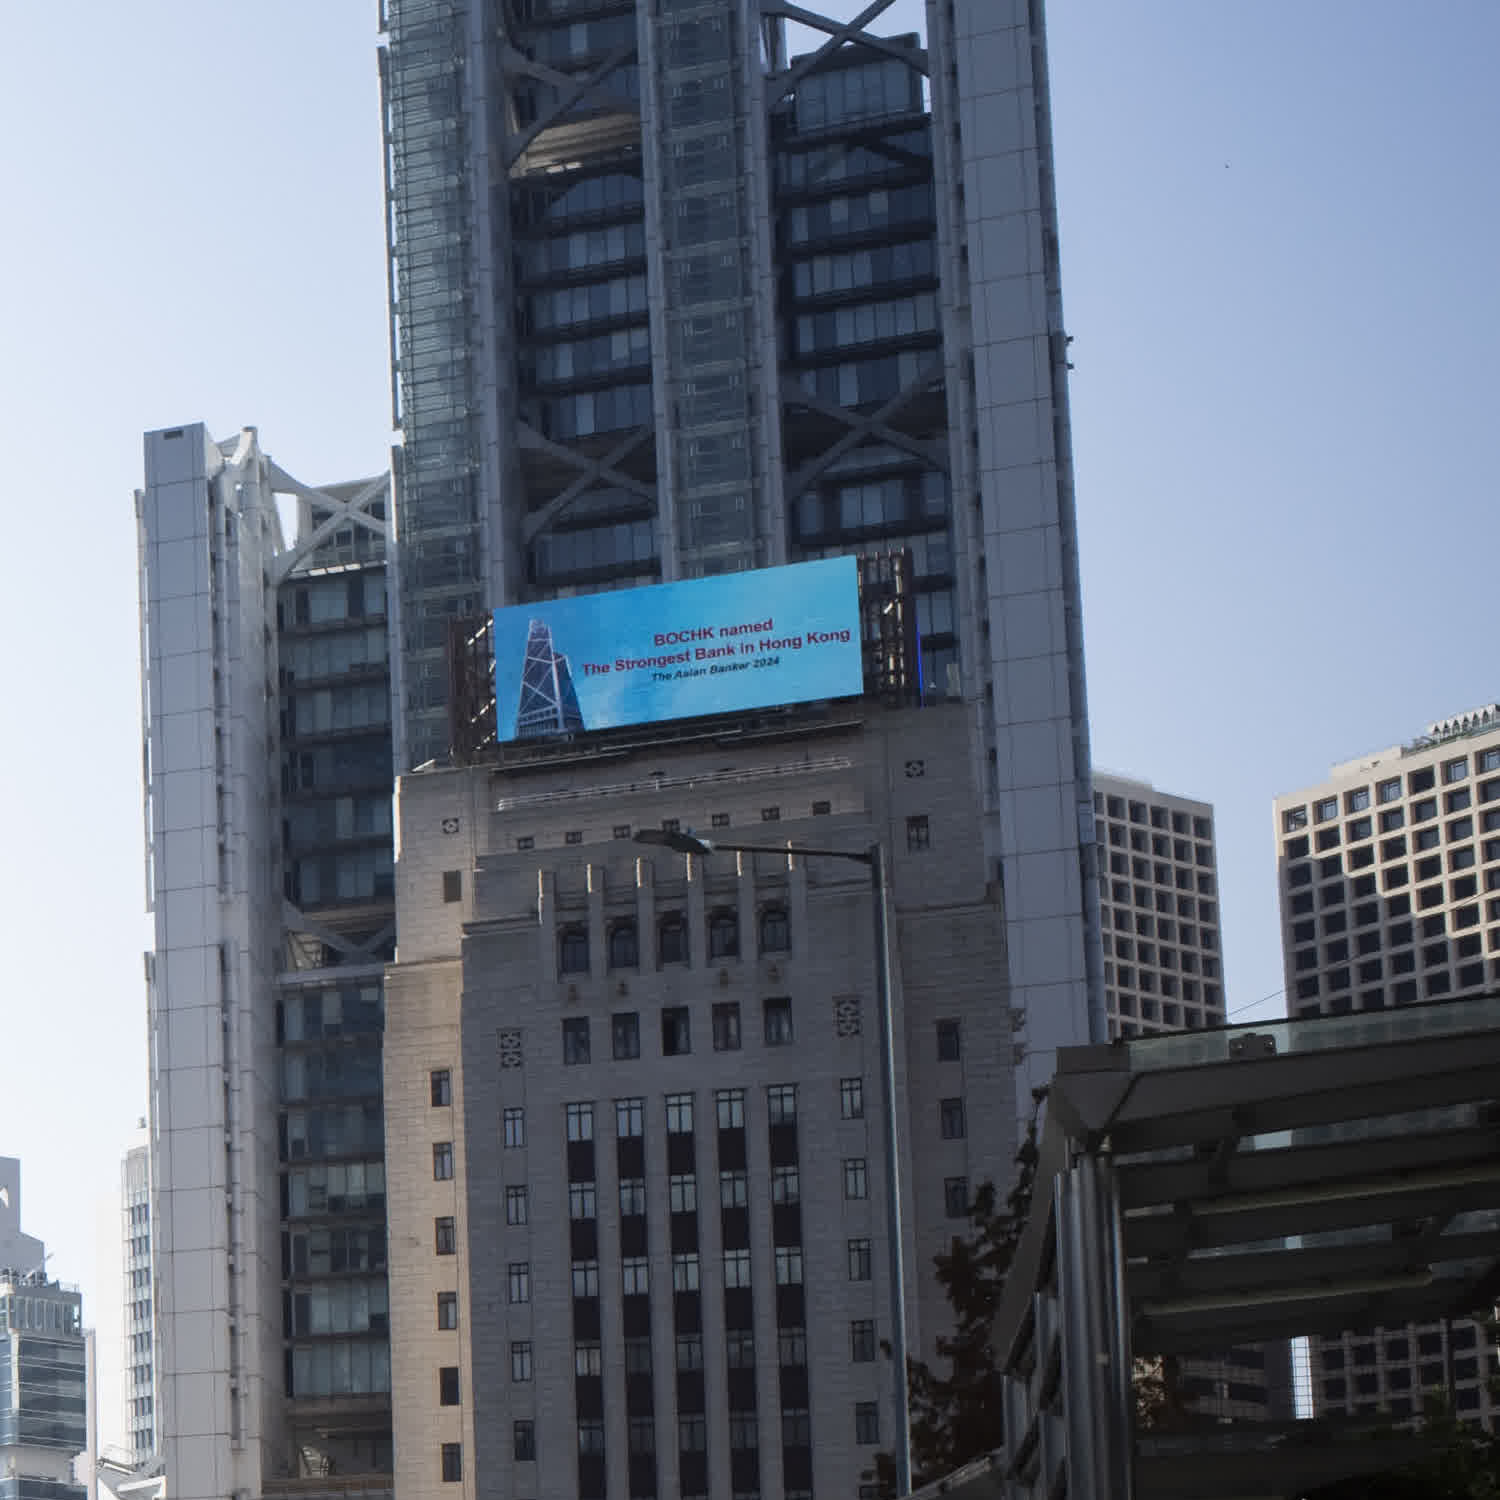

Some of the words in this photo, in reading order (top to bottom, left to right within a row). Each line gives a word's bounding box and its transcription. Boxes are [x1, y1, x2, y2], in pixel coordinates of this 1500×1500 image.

[653, 627, 715, 647] BOCHK
[719, 618, 773, 638] named
[581, 662, 610, 677] The
[615, 652, 691, 672] Strongest
[695, 645, 736, 661] Bank
[740, 643, 755, 654] in
[759, 636, 802, 652] Hong
[806, 628, 851, 645] Kong
[651, 671, 672, 682] The
[673, 667, 706, 681] Asian
[709, 661, 751, 675] Banker
